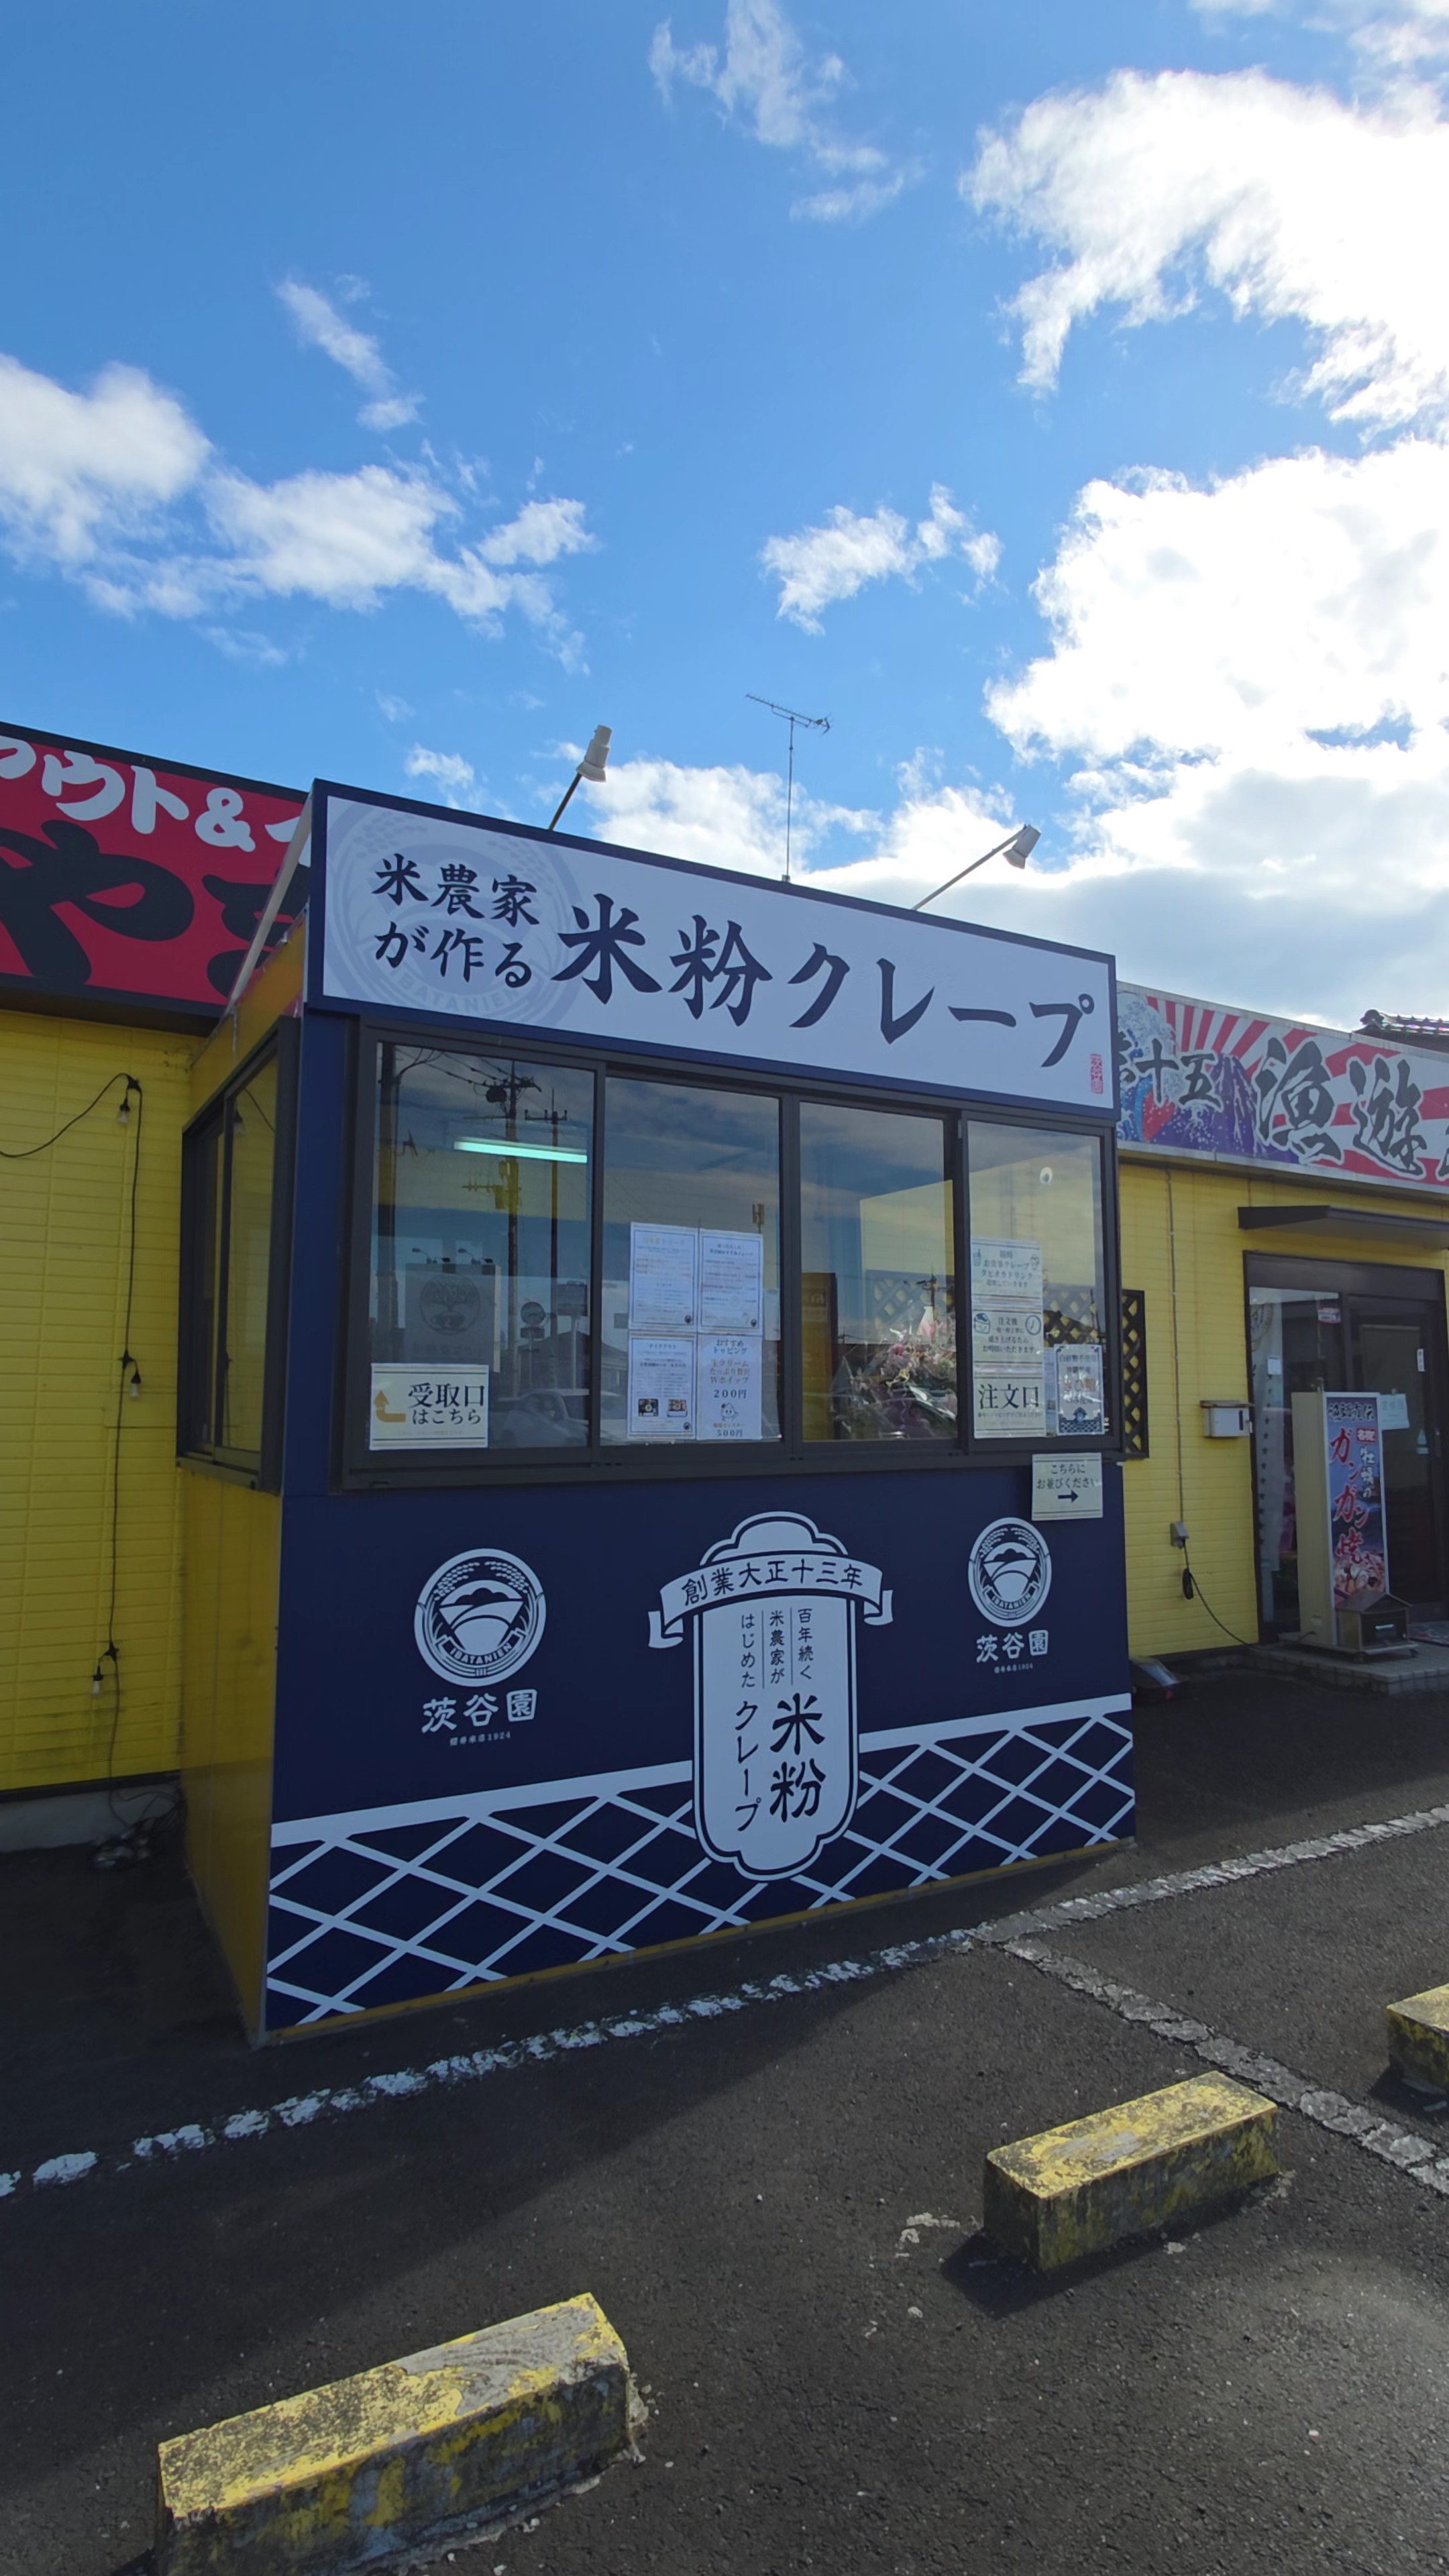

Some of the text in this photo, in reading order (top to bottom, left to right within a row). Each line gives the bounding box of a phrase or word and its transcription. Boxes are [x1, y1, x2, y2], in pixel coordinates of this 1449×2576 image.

[371, 853, 540, 928] 米農家
[374, 921, 533, 989] が作る
[550, 893, 1095, 1069] 米粉クレープ
[714, 1346, 747, 1355] トッピング
[408, 1382, 485, 1409] 受取口
[714, 1389, 747, 1399] 200円
[978, 1383, 1039, 1409] 注文口
[413, 1409, 481, 1425] はこちら
[1036, 1477, 1099, 1490] お並びください
[1051, 1464, 1085, 1475] こちらに
[681, 1560, 864, 1607] 創業大正十三年
[450, 1644, 513, 1664] IBATANIEN
[741, 1613, 757, 1688] はじめた
[769, 1610, 786, 1684] 米農家が
[797, 1608, 814, 1680] 百年続く
[976, 1629, 1049, 1663] 茨谷園
[421, 1688, 537, 1733] 茨谷園
[735, 1700, 761, 1832] クレープ
[769, 1693, 826, 1823] 米粉
